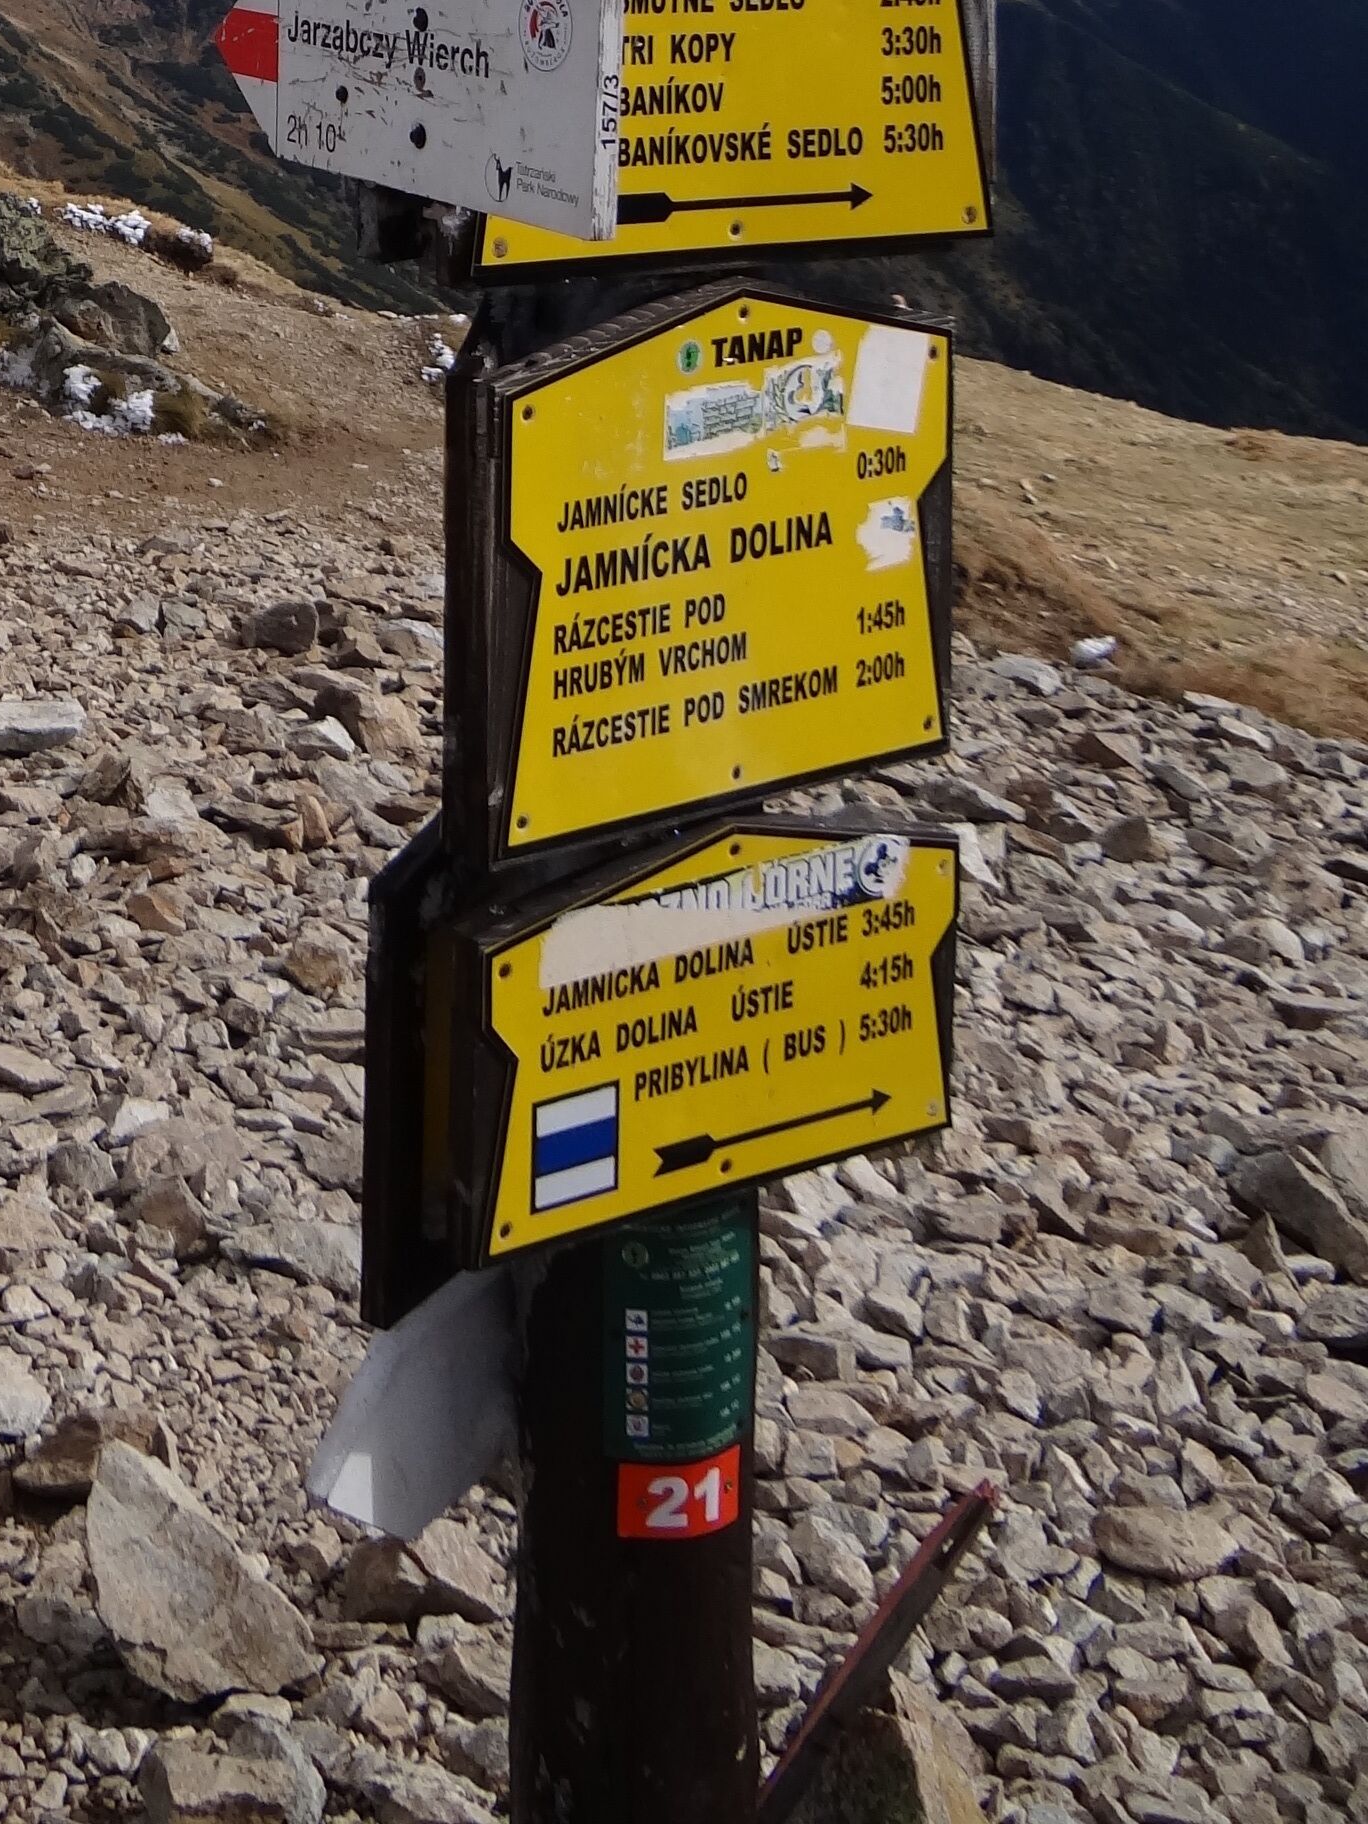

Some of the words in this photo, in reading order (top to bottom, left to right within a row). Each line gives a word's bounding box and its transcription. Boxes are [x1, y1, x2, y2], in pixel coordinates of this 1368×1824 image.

[287, 10, 398, 69] Jarząbczy
[405, 29, 490, 79] Wierch
[670, 32, 736, 64] KOPY
[881, 25, 942, 57] 3:30h
[601, 74, 620, 150] 157/3
[619, 75, 724, 117] BANÍKOV
[881, 74, 942, 106] 5:00h
[617, 122, 772, 168] BANÍKOVSKÉ
[786, 126, 864, 159] SEDLO
[883, 122, 944, 154] 5:30h
[516, 178, 535, 194] Park
[537, 183, 580, 207] Narodowy
[711, 327, 803, 368] TANAP
[557, 483, 668, 533] JAMNÍCKE
[681, 472, 748, 511] SEDLO
[856, 445, 906, 480] 0:30h
[555, 533, 711, 597] JAMNÍCKA
[730, 511, 833, 564] DOLINA
[553, 603, 671, 655] RÁZCESTIE
[684, 593, 726, 629] POD
[857, 600, 905, 635] 1:45h
[553, 647, 645, 700] HRUBÝM
[658, 630, 747, 678] VRCHOM
[552, 703, 670, 758] RÁZCESTIE
[684, 691, 725, 727] POD
[738, 665, 838, 714] SMREKOM
[856, 651, 905, 688] 2:00h
[674, 937, 755, 984] DOLINA
[787, 912, 848, 955] ÚSTIE
[862, 900, 916, 937] 3:45h
[540, 1030, 602, 1073] ÚZKA
[616, 1005, 698, 1053] DOLINA
[731, 979, 794, 1022] ÚSTIE
[859, 953, 914, 989] 4:15h
[633, 1044, 750, 1102] PRIBYLINA
[783, 1024, 826, 1062] BUS
[859, 1004, 912, 1042] 5:30h
[645, 1466, 721, 1529] 21
